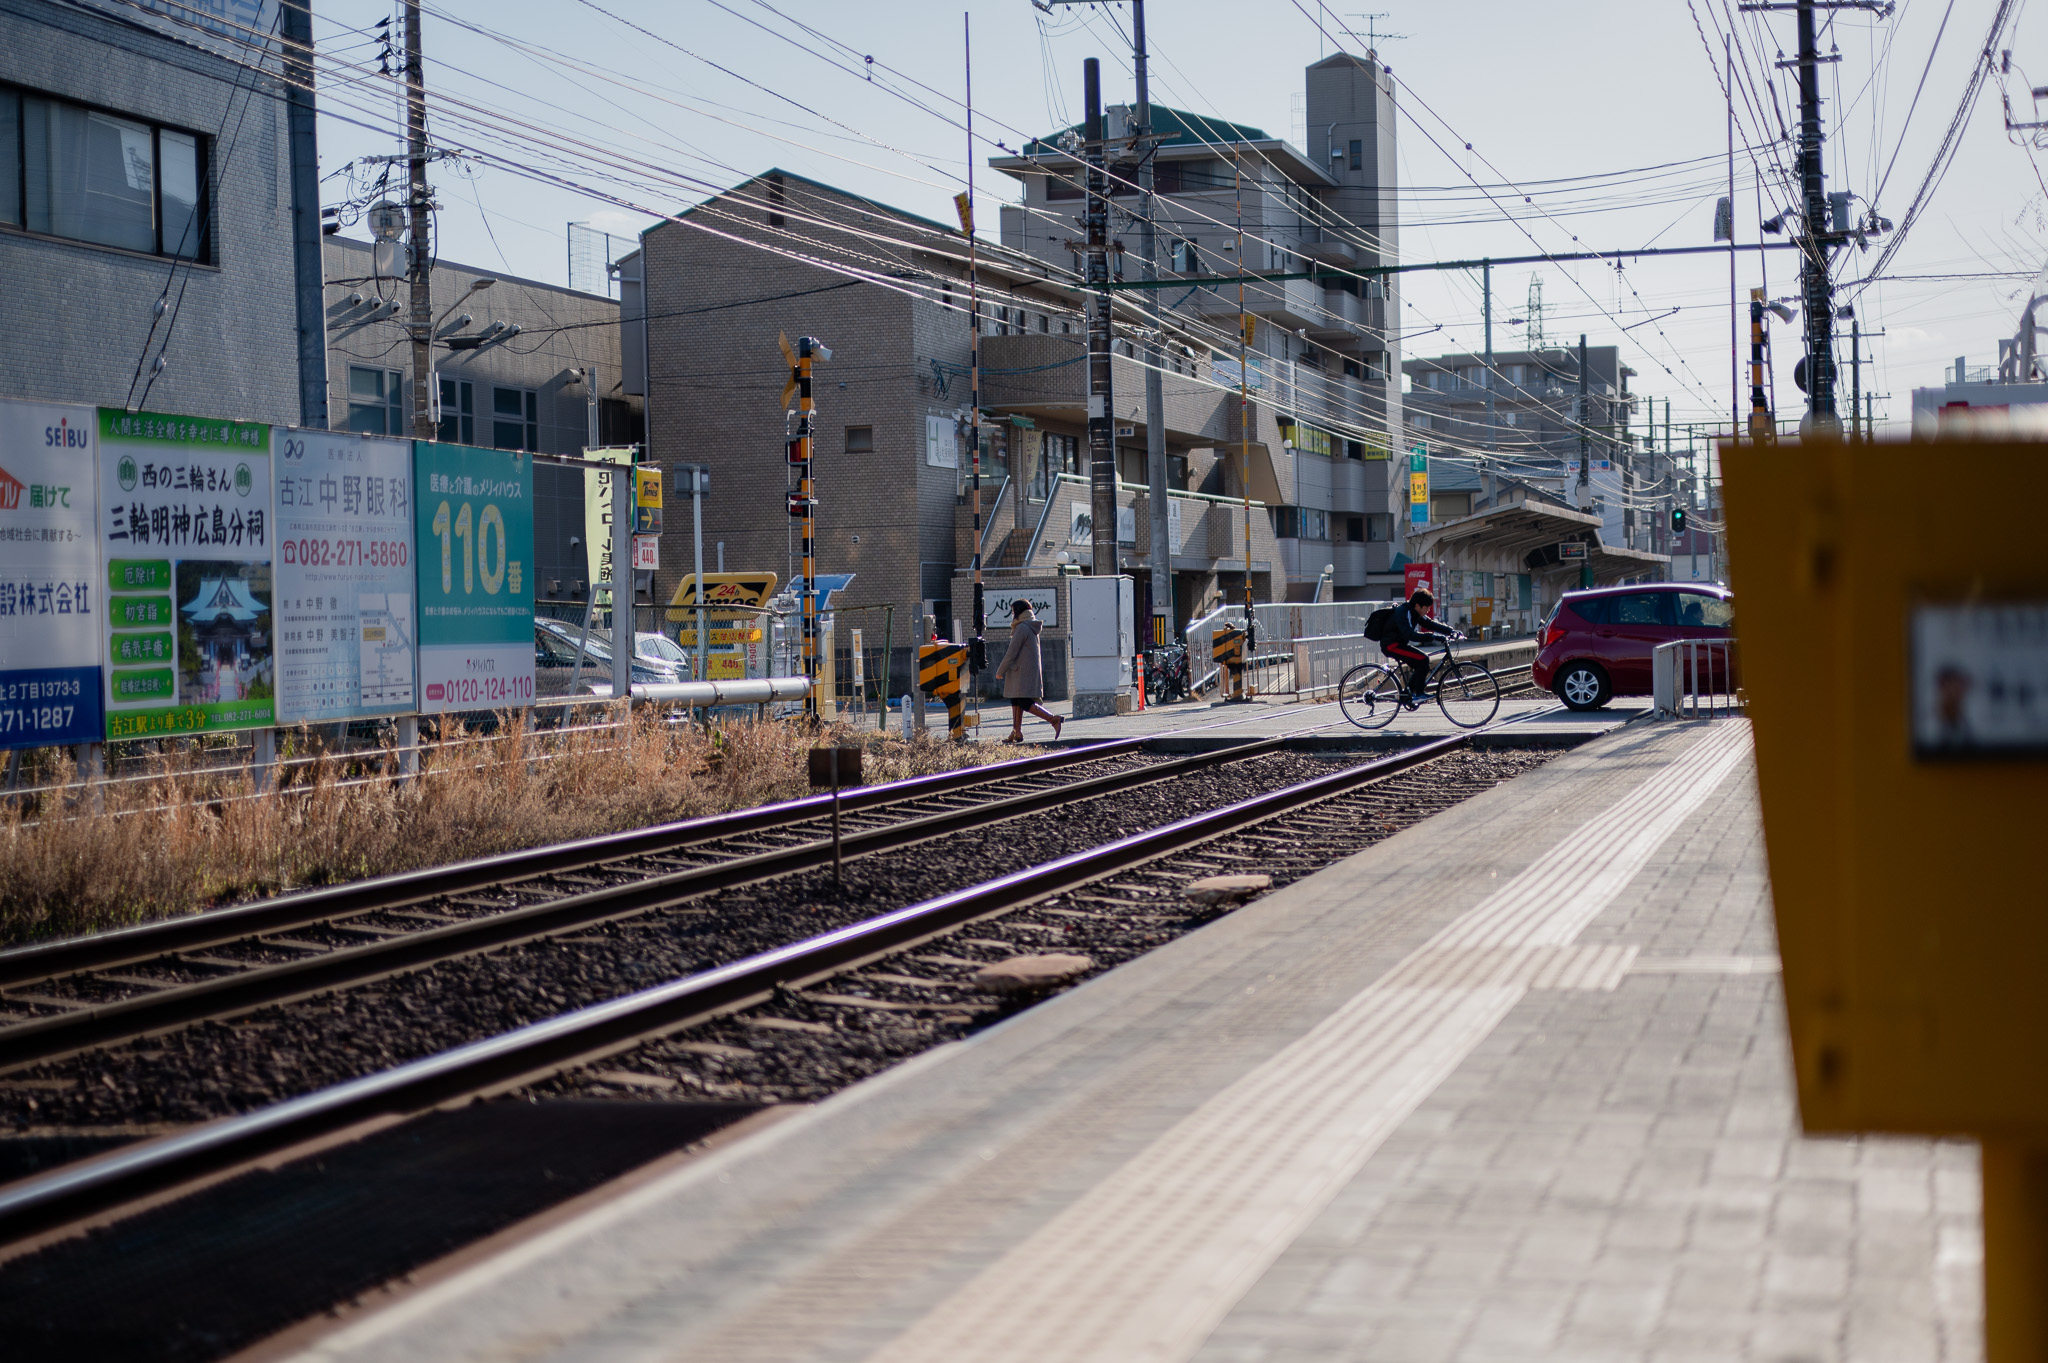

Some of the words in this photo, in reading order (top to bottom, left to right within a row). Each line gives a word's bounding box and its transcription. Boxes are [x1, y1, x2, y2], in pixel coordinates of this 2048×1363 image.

[108, 416, 261, 447] 人間生活全般を幸せに導く神様
[327, 448, 363, 463] 医療法人
[142, 463, 232, 493] 西の三輪さん
[430, 473, 522, 498] 医療と介護のメリィハウス
[29, 484, 71, 509] 届けて
[279, 472, 408, 518] 古江中野眼科
[108, 501, 265, 548] 三輪明神広島分祠
[299, 538, 408, 567] 082-271-5860
[124, 566, 156, 585] 厄除け
[124, 604, 158, 621] 初宮詣
[120, 639, 163, 661] 病気平癒
[446, 675, 533, 704] 0120-124-110
[111, 708, 208, 737] 古江駅より車で3分
